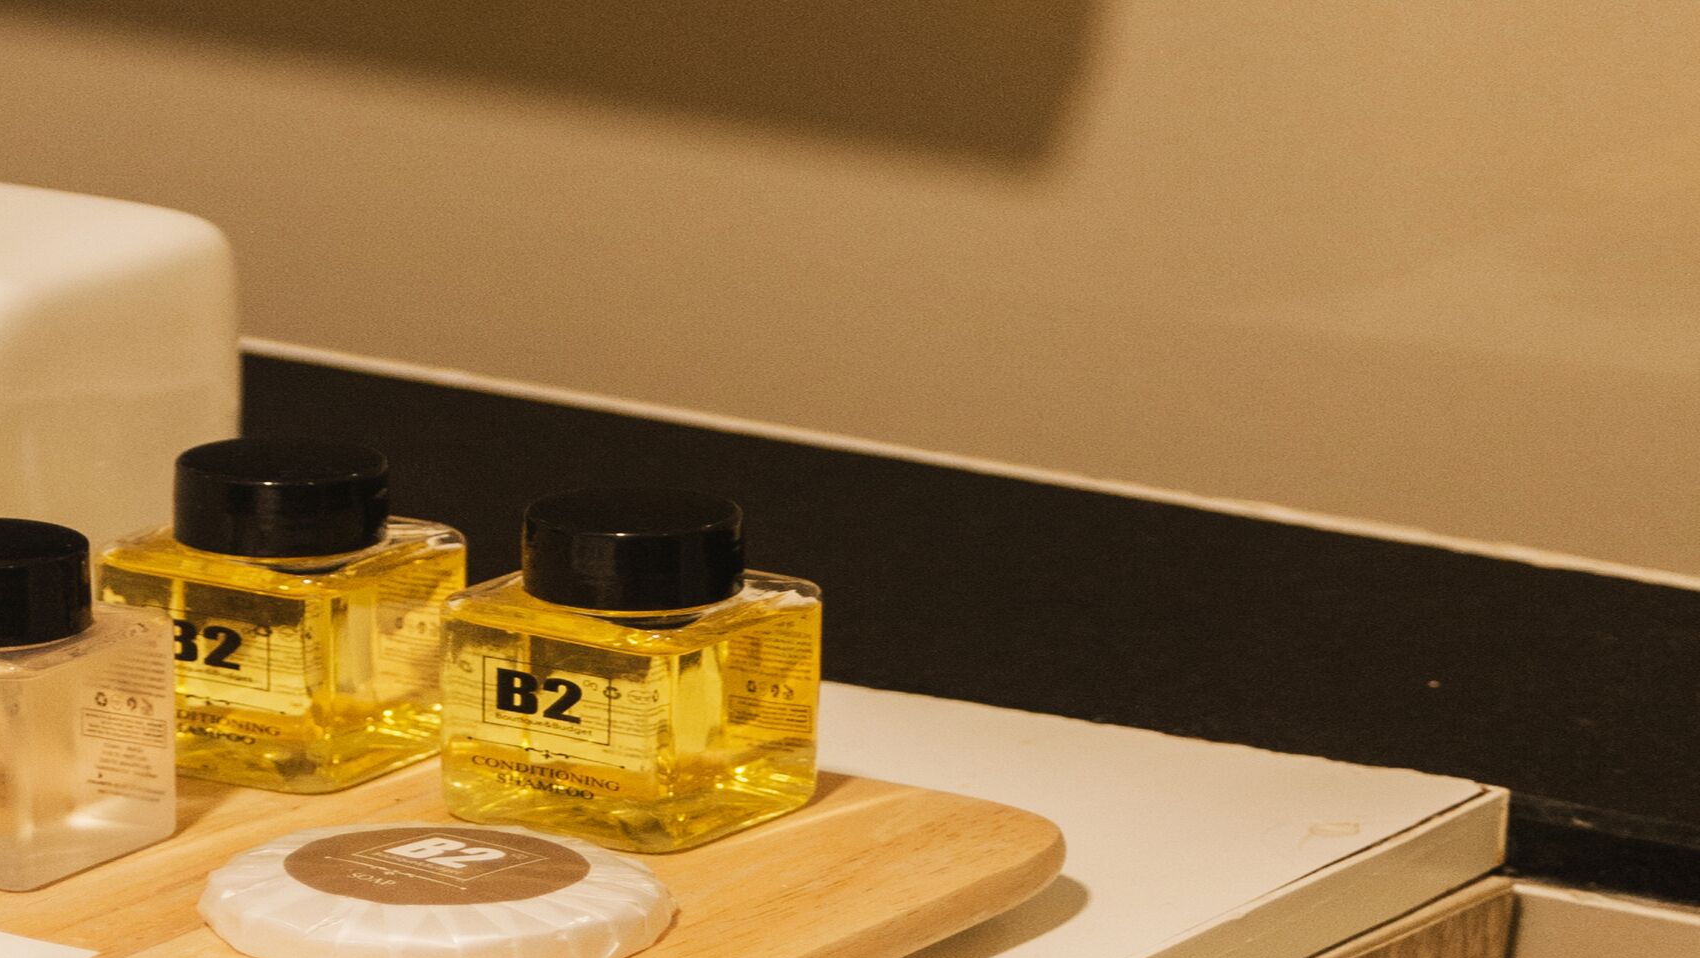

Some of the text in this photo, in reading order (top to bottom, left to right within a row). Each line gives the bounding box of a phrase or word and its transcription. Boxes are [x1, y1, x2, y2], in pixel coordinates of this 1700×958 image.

[174, 619, 243, 671] B2
[496, 667, 583, 725] B2
[176, 709, 281, 736] DITIONING
[471, 754, 621, 792] CONDITIONING
[383, 837, 507, 869] B2
[349, 872, 397, 887] SOAP
